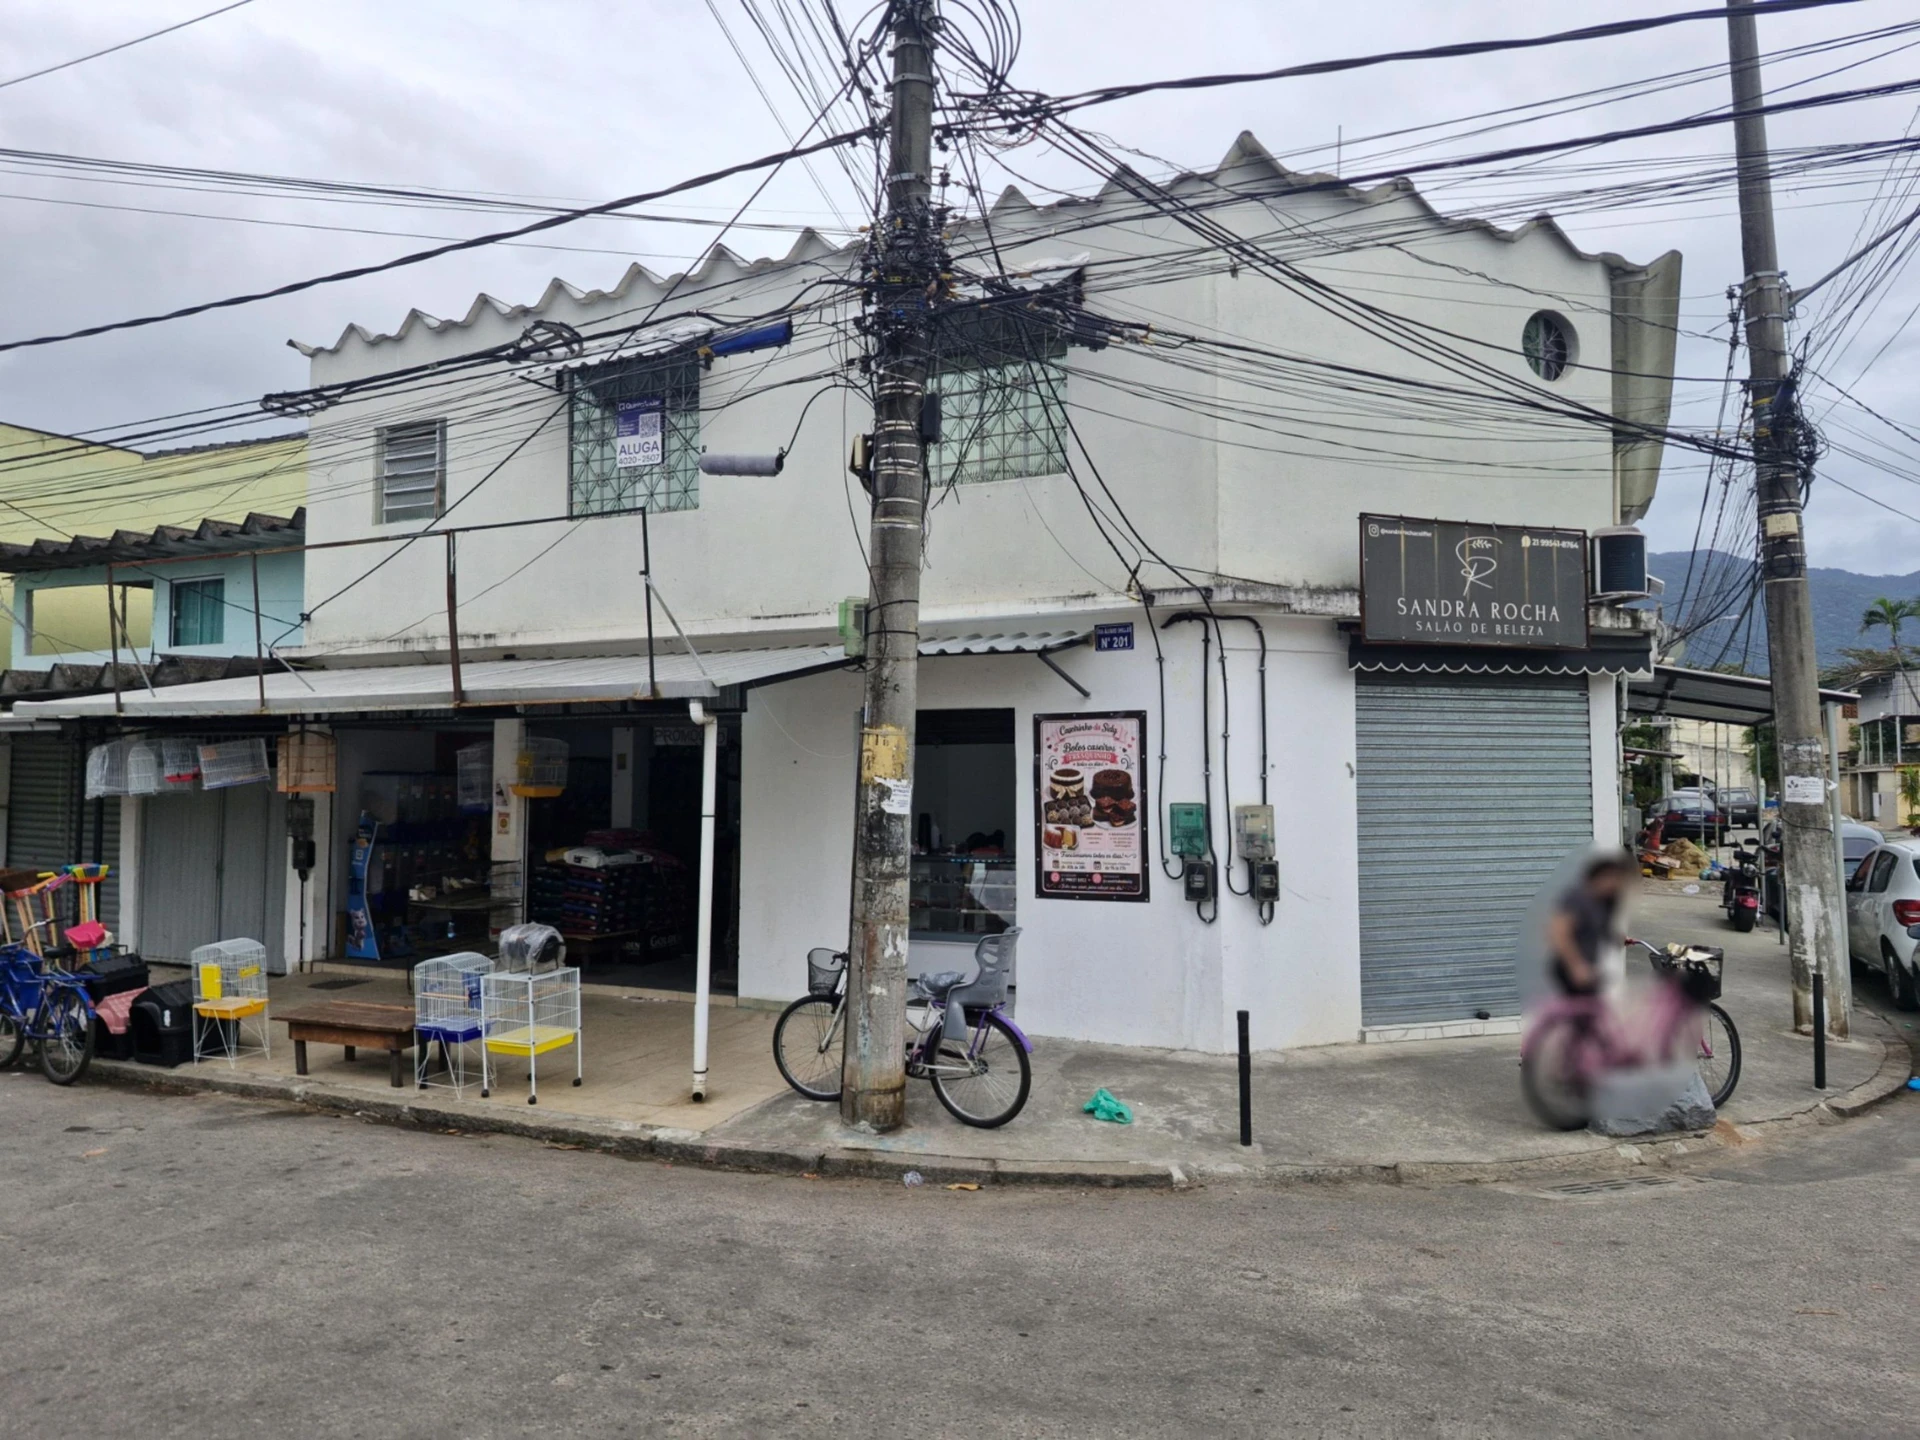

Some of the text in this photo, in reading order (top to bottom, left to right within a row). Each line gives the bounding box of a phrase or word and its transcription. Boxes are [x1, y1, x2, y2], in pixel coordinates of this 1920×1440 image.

[619, 441, 660, 456] ALUGA
[1397, 597, 1560, 623] SANDRA ROCHA
[1416, 619, 1544, 637] SALÃO DE BELEZA
[1112, 636, 1129, 648] 201
[655, 729, 725, 743] PROMOO
